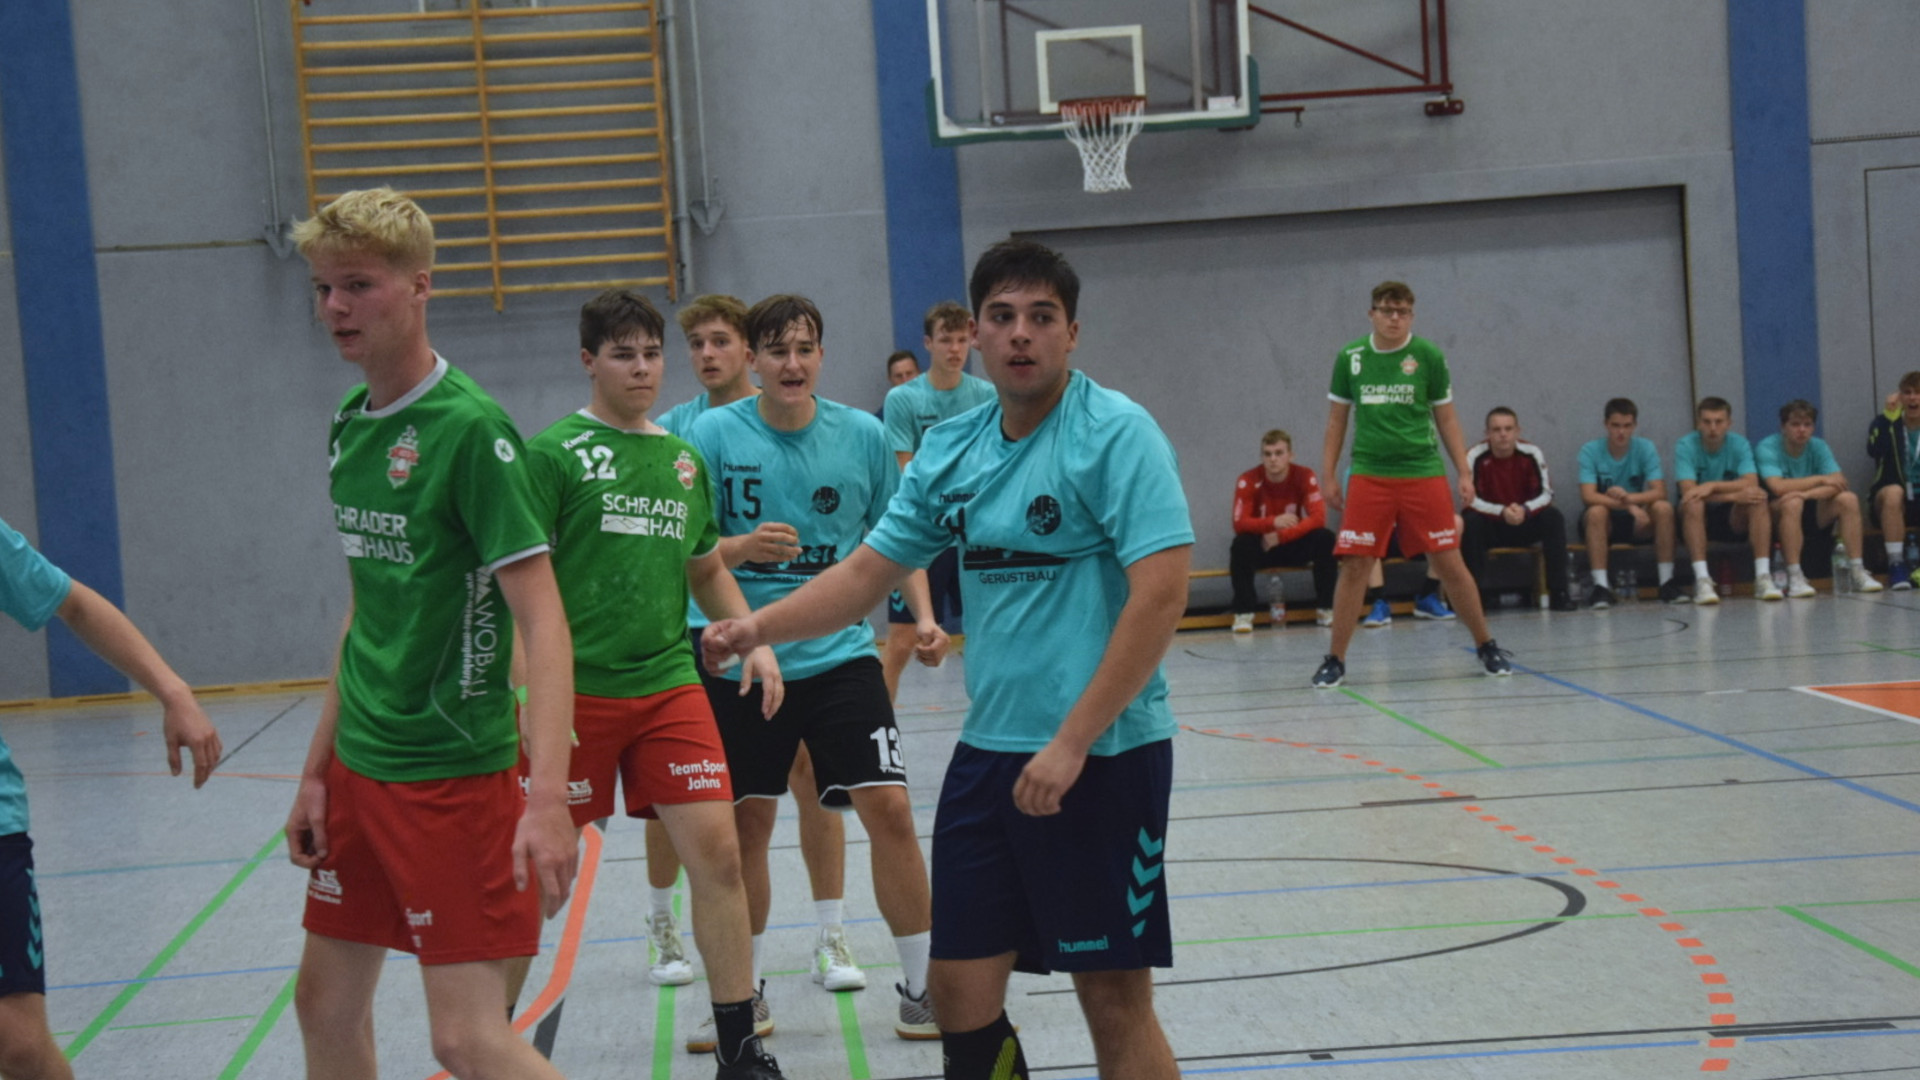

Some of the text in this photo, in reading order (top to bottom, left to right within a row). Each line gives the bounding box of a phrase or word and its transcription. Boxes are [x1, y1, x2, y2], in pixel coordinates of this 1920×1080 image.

[1351, 353, 1361, 376] 6
[1360, 384, 1415, 395] SCHRADER
[1388, 394, 1415, 405] HAUS
[561, 430, 595, 451] Kempa
[575, 445, 617, 481] 12
[723, 461, 762, 473] hummel
[723, 477, 762, 521] 15
[363, 536, 415, 565] HAUS
[870, 726, 905, 768] 13
[688, 775, 721, 791] Jahns
[1058, 935, 1109, 953] hummel
